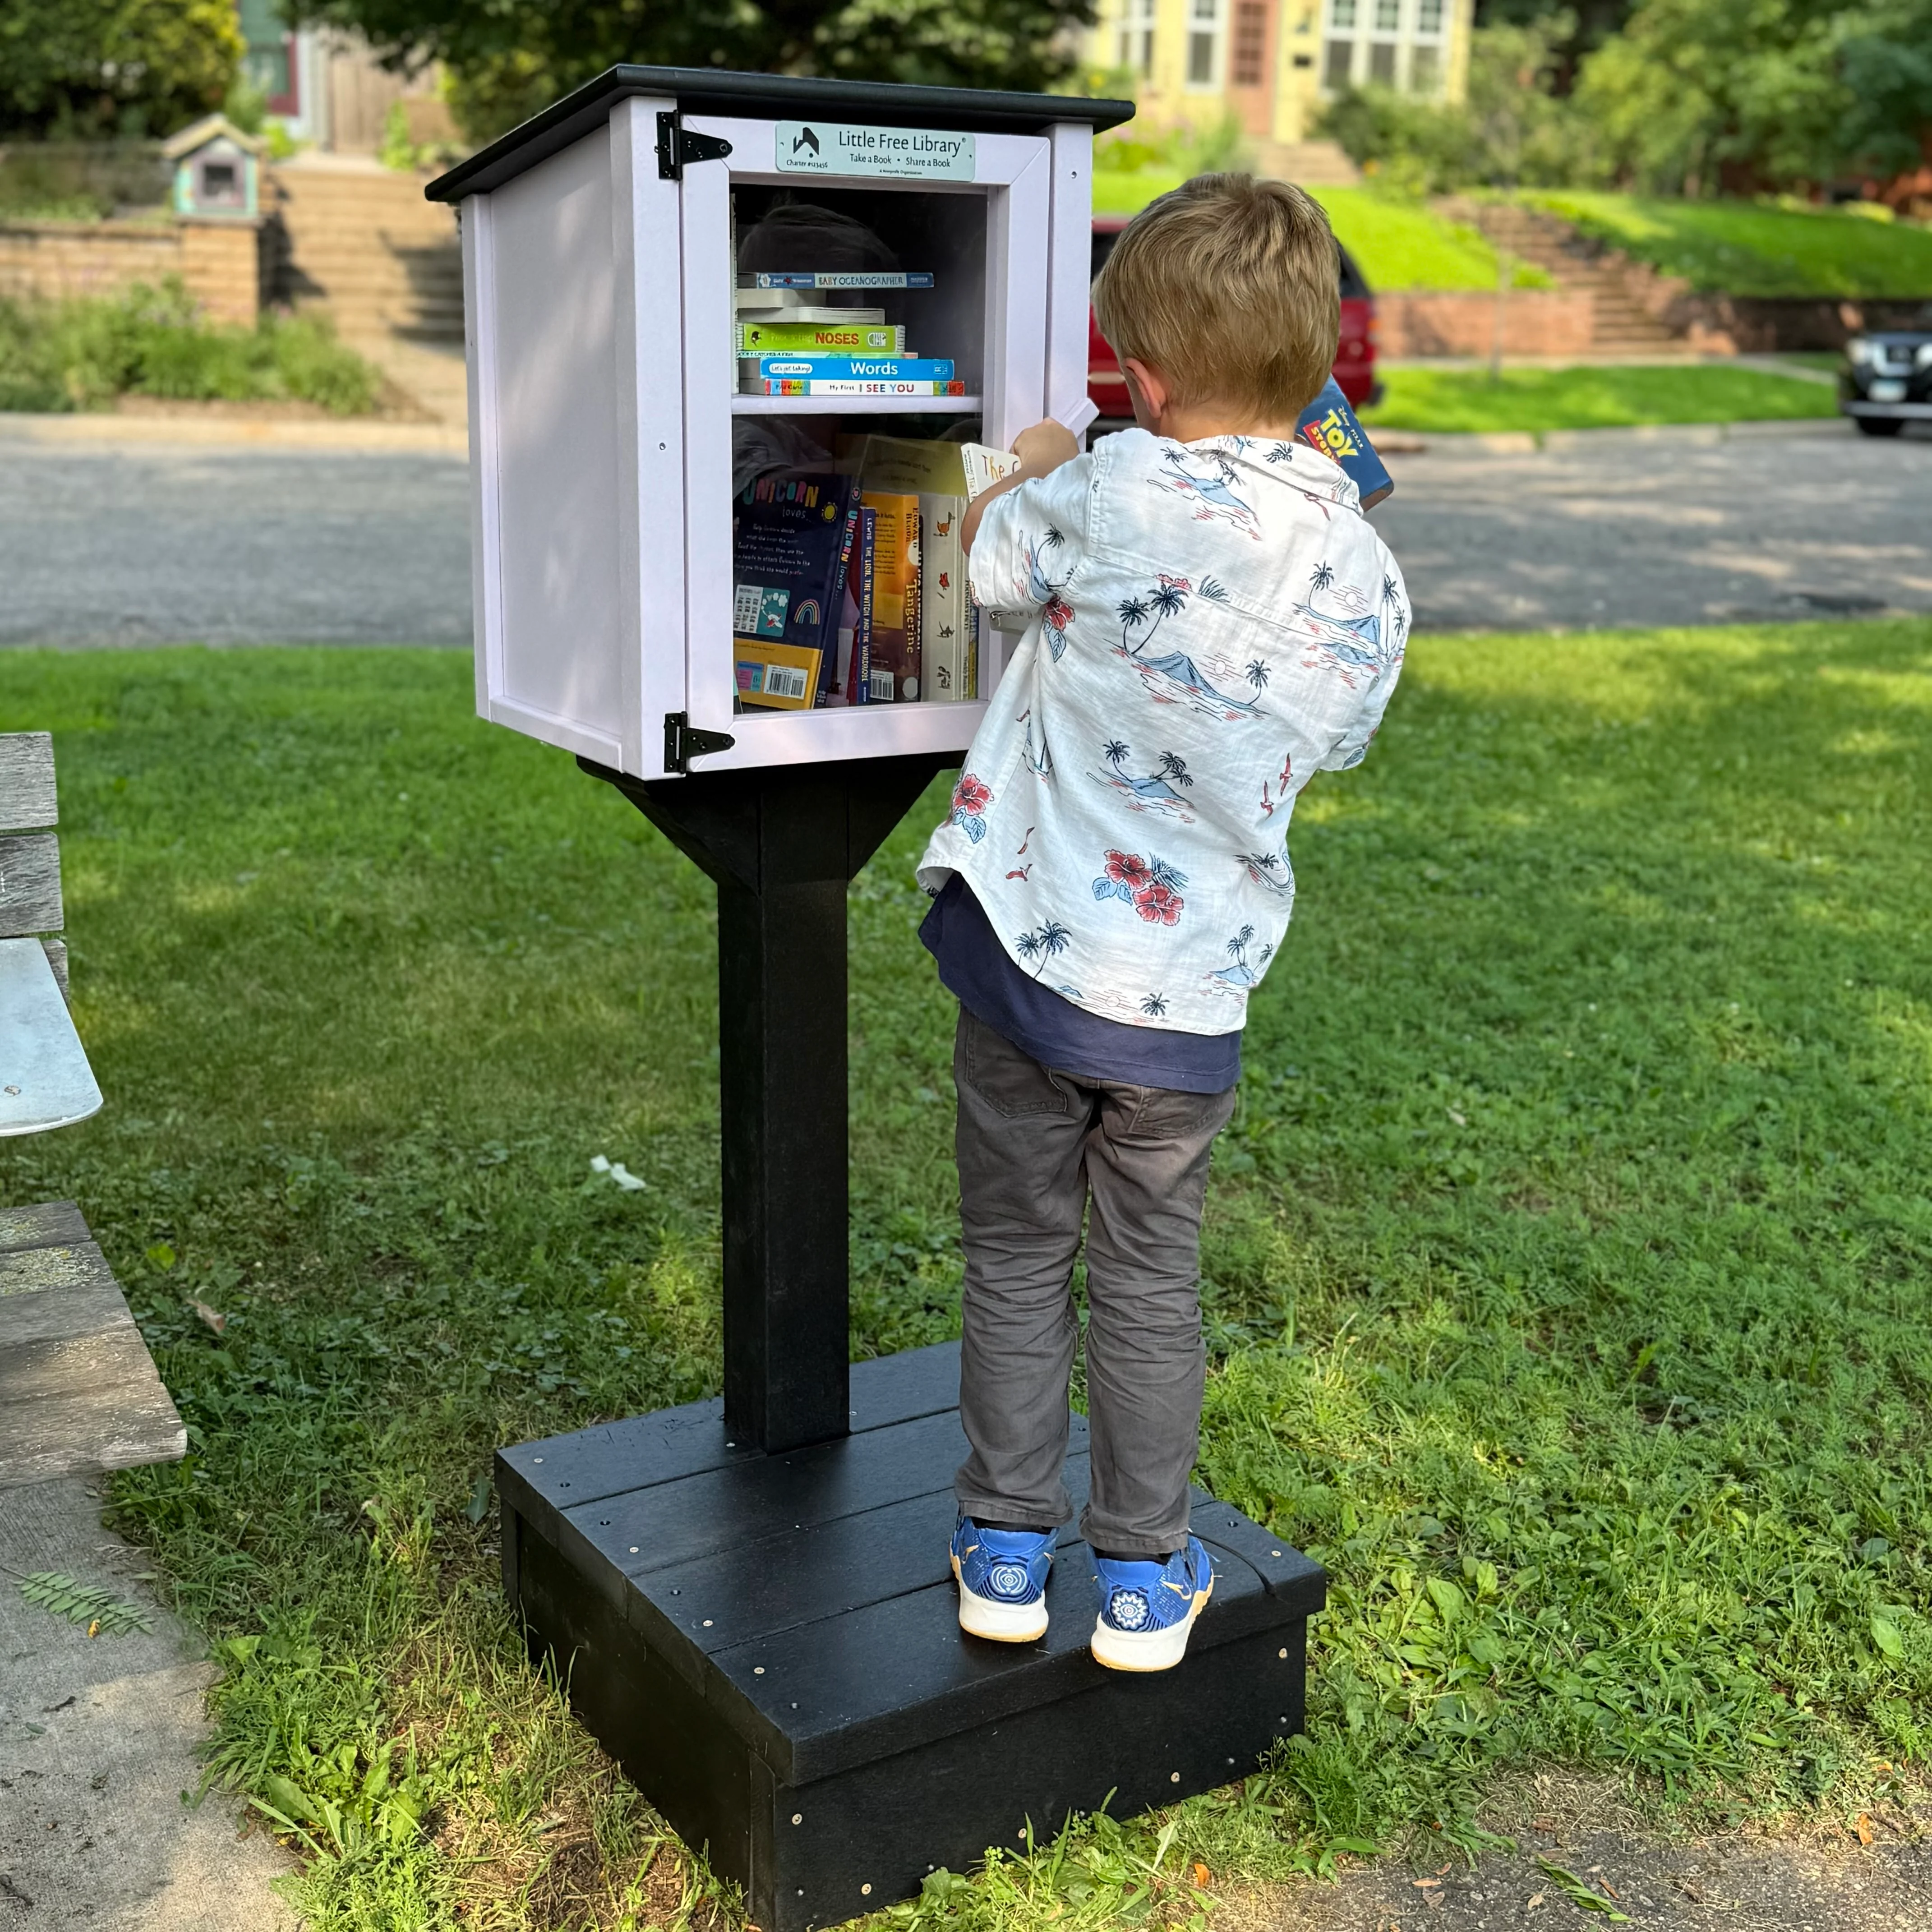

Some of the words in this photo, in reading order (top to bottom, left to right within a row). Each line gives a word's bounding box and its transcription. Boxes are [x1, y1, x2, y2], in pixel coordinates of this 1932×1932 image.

[839, 131, 875, 148] Little
[880, 134, 908, 150] Free
[850, 153, 866, 162] Take
[874, 155, 892, 164] Book
[906, 157, 925, 166] Share
[933, 158, 950, 167] Book
[819, 276, 837, 285] BABY
[839, 276, 903, 285] OCEANOGRAPHER
[815, 332, 859, 345] NOSES
[851, 362, 898, 375] Words
[859, 384, 862, 392] I
[866, 384, 885, 392] SEE
[890, 384, 914, 392] YOU
[1320, 408, 1359, 458] TOY
[1350, 429, 1364, 449] PIXAR
[982, 455, 1005, 480] The
[742, 478, 819, 507] UNICORN
[841, 510, 858, 563] UNICORN
[905, 579, 917, 654] Tangerine
